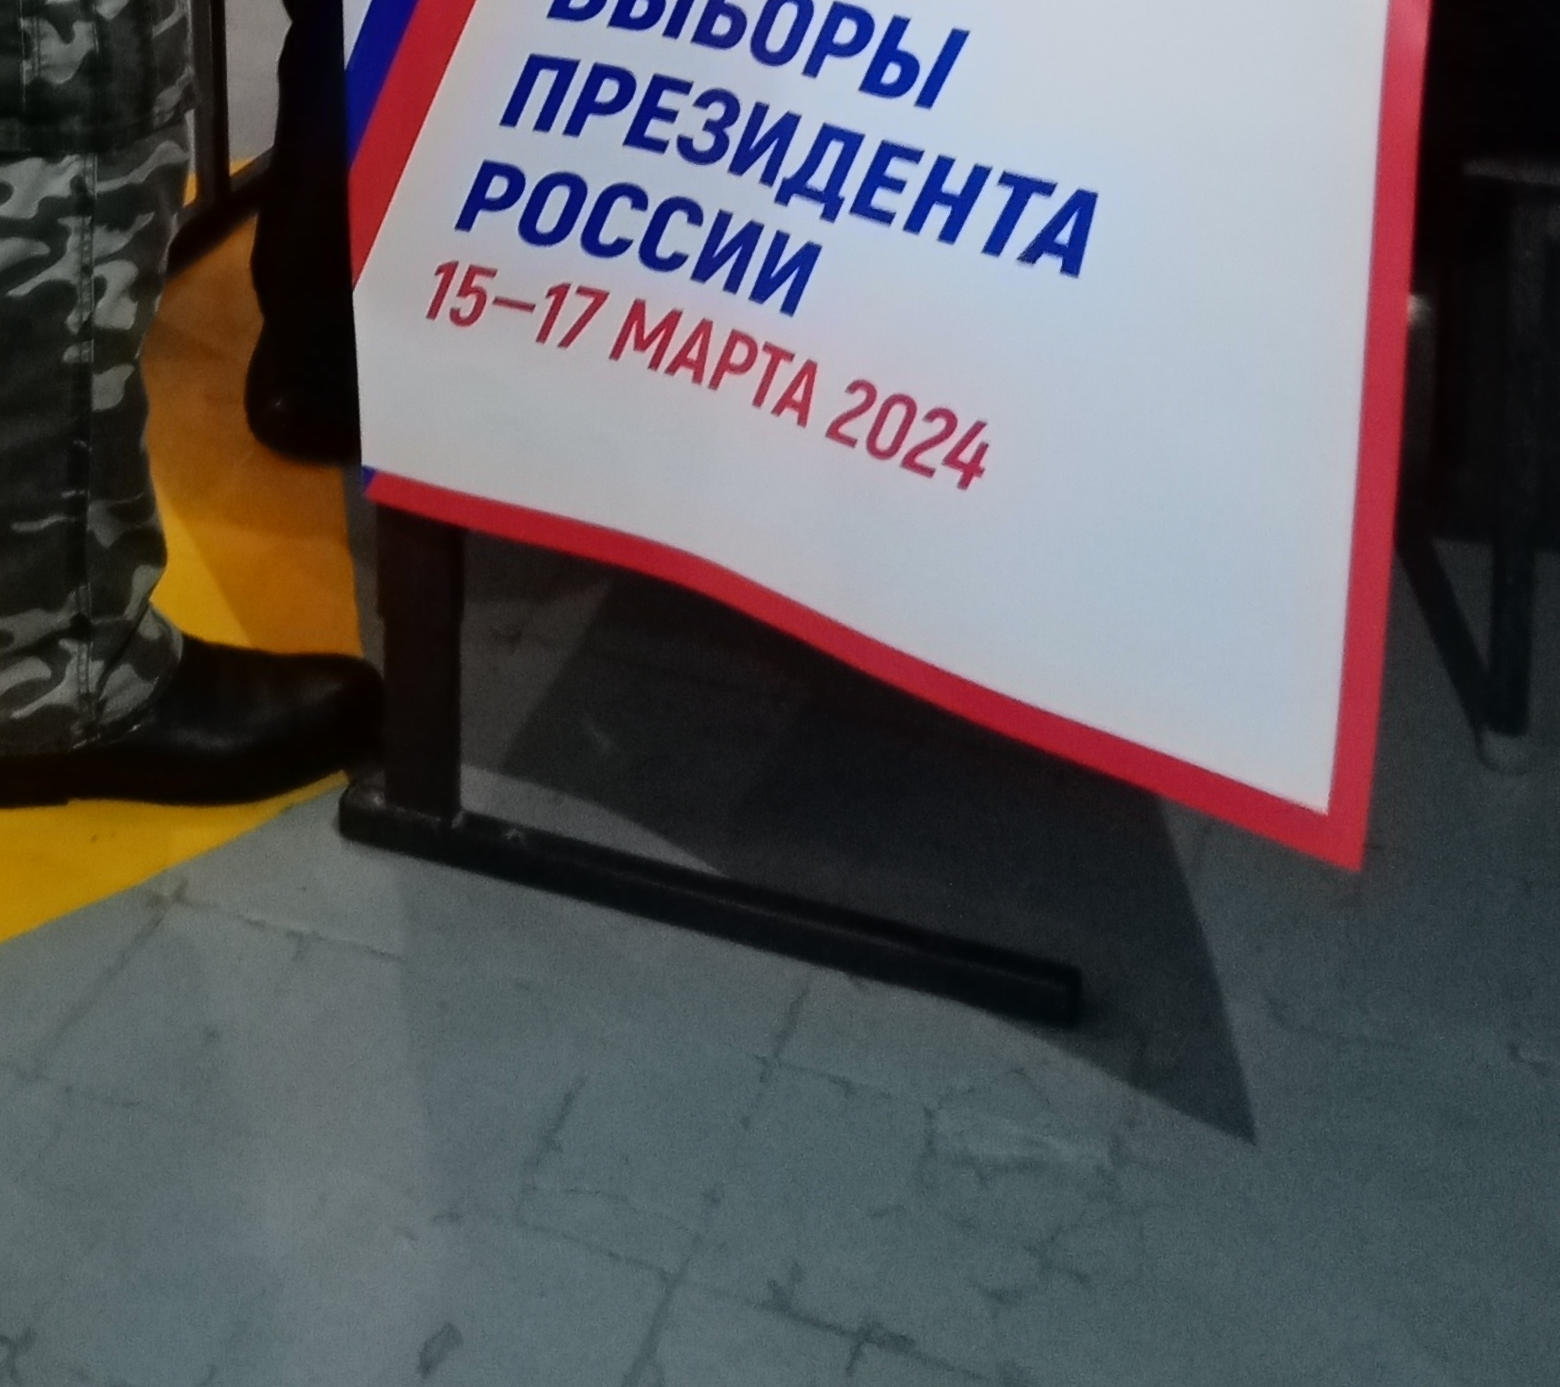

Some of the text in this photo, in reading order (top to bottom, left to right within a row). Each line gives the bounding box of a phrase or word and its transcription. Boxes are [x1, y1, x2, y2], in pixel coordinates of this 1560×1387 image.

[456, 160, 823, 317] РОССИИ
[500, 54, 1100, 279] ПРЕЗИДЕНТА
[609, 299, 818, 427] МАРТА
[826, 380, 991, 490] 2024
